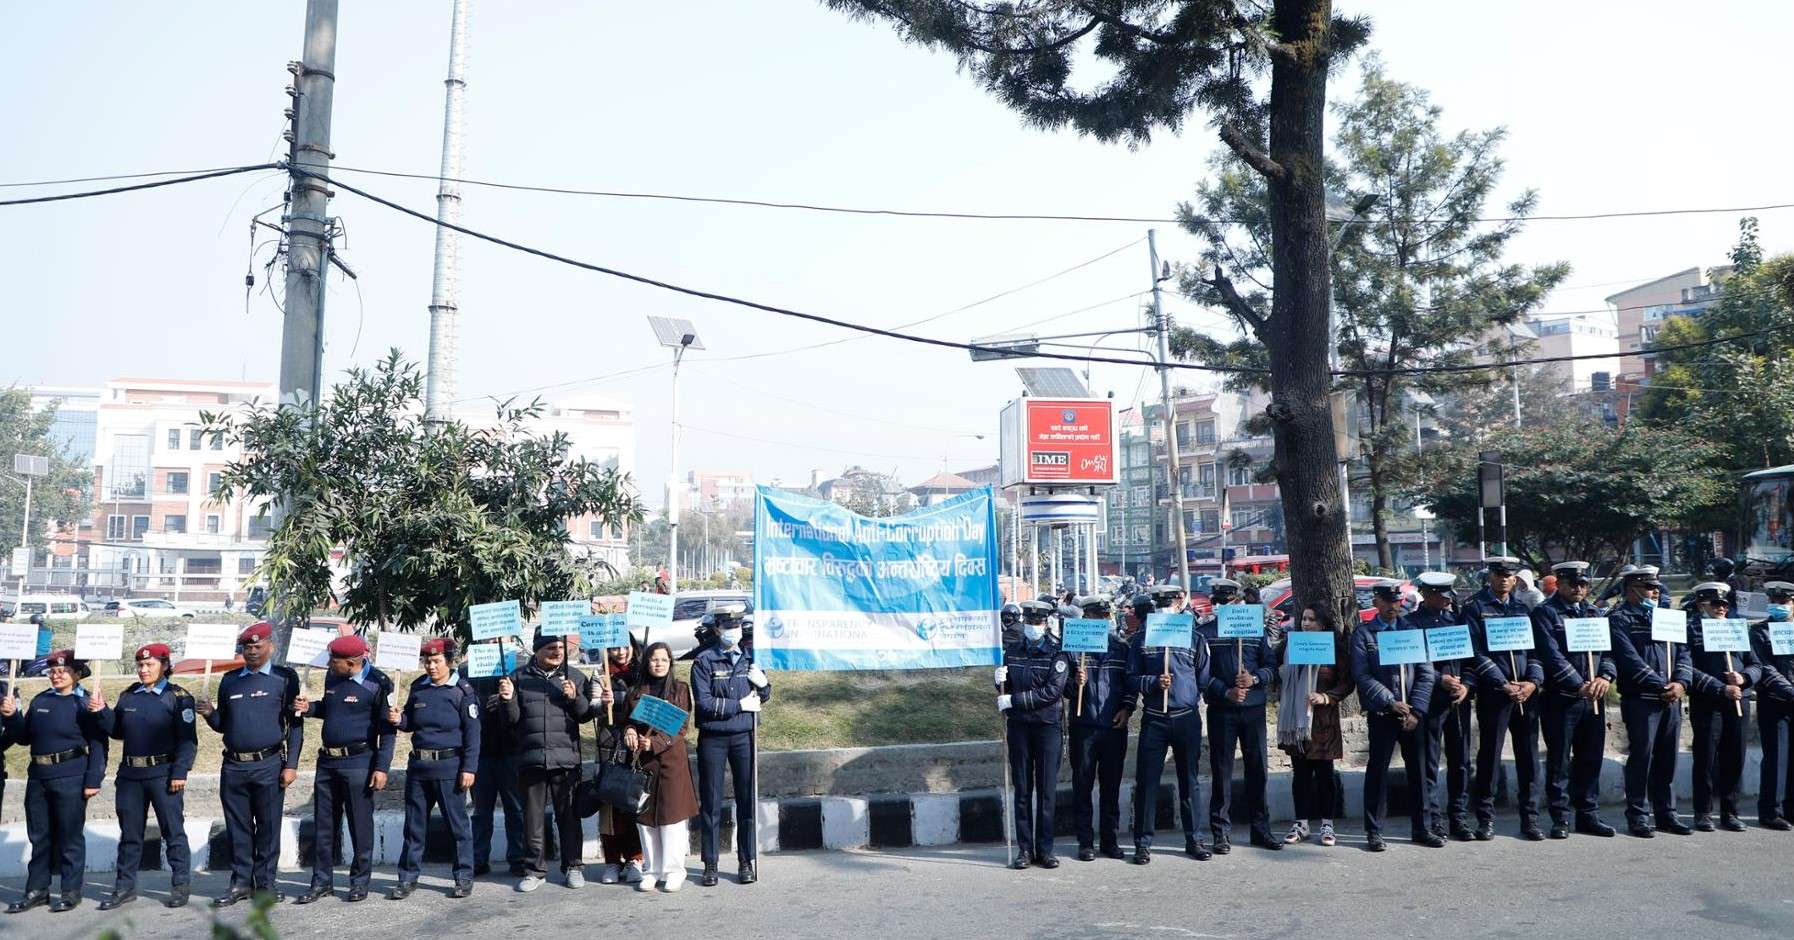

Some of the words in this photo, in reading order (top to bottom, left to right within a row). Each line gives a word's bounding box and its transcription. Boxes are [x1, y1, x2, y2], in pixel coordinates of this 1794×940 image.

[1038, 454, 1067, 465] IME
[766, 517, 851, 543] International
[855, 519, 959, 547] Anti-Corruption
[963, 516, 985, 544] Day
[954, 552, 987, 577] दिवस
